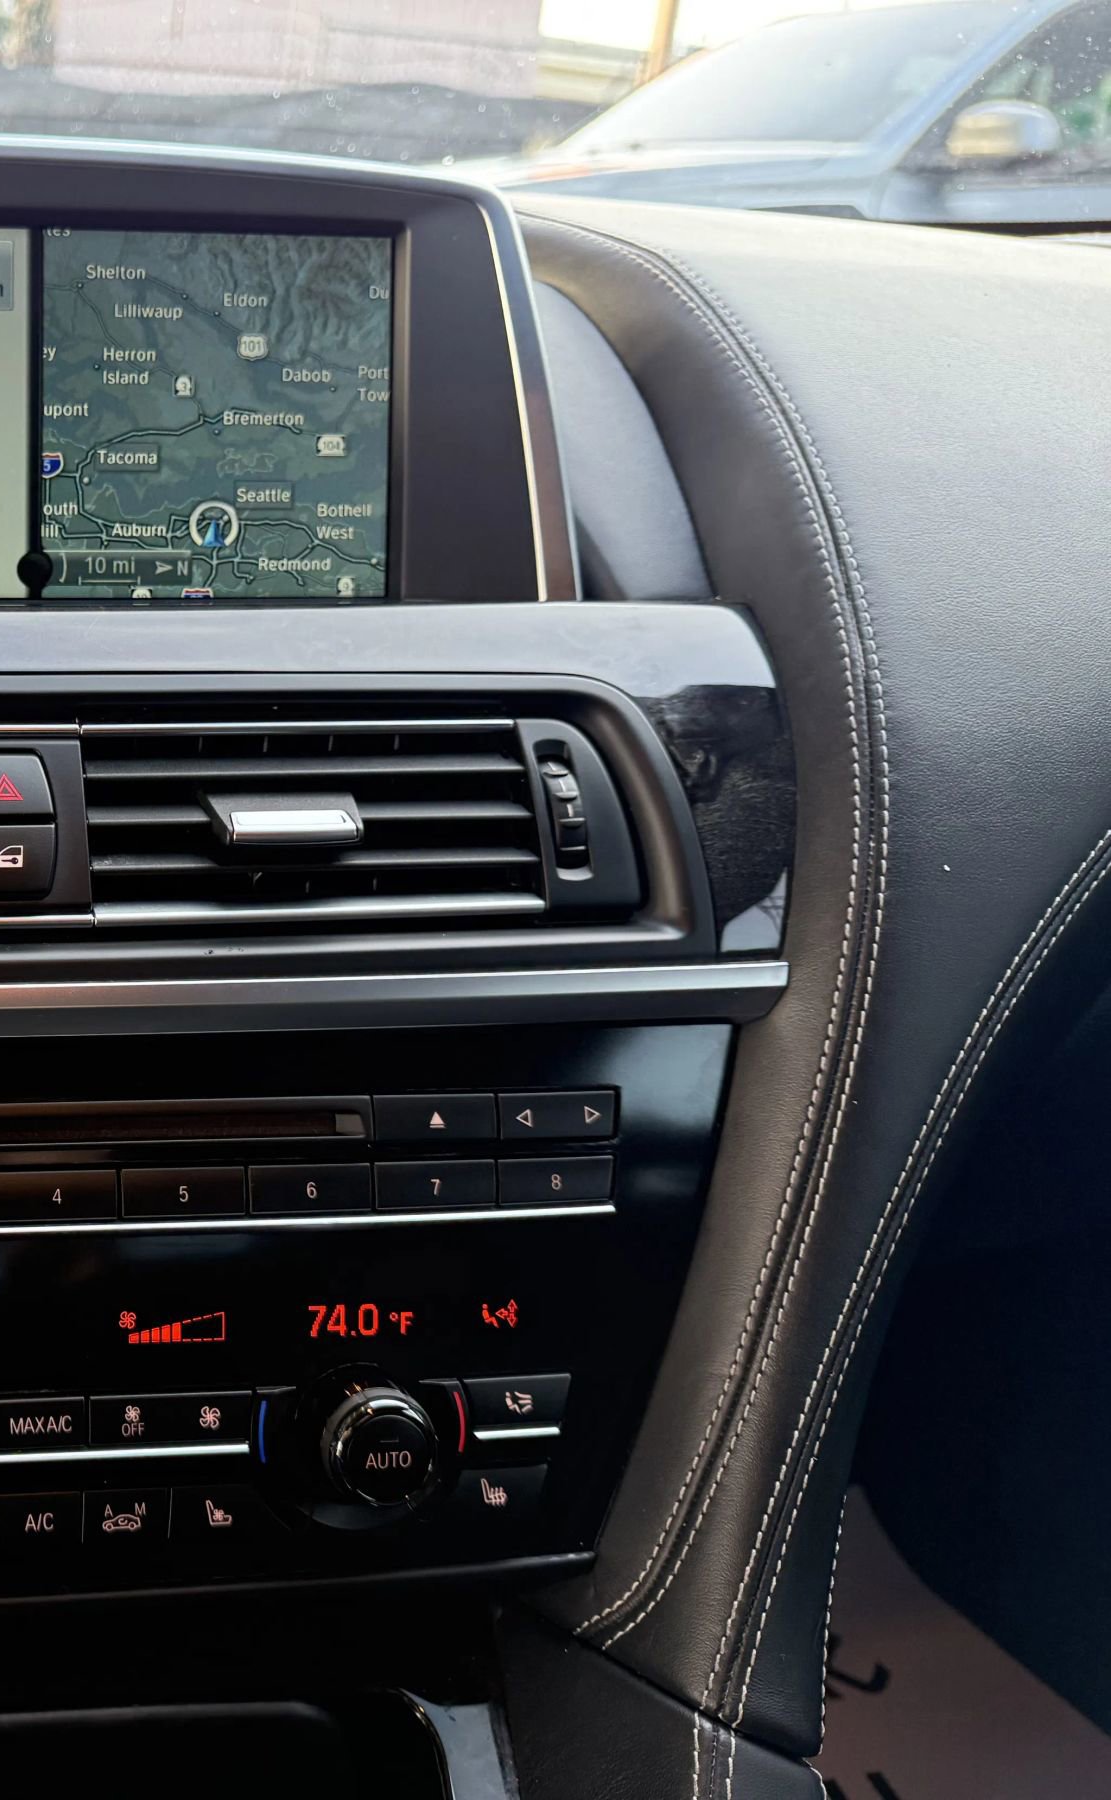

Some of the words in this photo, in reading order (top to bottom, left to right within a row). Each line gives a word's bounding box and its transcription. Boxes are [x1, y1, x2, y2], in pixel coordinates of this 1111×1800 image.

[86, 264, 146, 280] Shelton
[223, 293, 268, 308] Eldon
[114, 304, 183, 320] Lilliwaup
[243, 340, 262, 350] 101
[103, 347, 157, 362] Herron
[103, 371, 149, 385] Island
[282, 368, 332, 383] Dabob
[358, 366, 388, 380] Port
[43, 403, 89, 419] upont
[223, 411, 304, 426] Bremerton
[97, 450, 158, 465] Tacoma
[43, 460, 51, 472] 5
[237, 488, 291, 503] Seattle
[43, 502, 78, 516] outh
[316, 503, 371, 518] Bothell
[112, 523, 167, 537] Auburn
[316, 525, 354, 540] West
[85, 556, 107, 574] 10
[113, 556, 135, 574] mi
[177, 561, 188, 576] N
[258, 557, 331, 571] Redmond
[430, 1179, 440, 1196] 7
[550, 1175, 561, 1190] 8
[52, 1189, 62, 1206] 4
[178, 1186, 189, 1202] 5
[306, 1182, 317, 1199] 6
[307, 1303, 379, 1338] 74.0
[389, 1311, 414, 1335] °F
[9, 1417, 46, 1434] MAX
[46, 1415, 72, 1433] A/C
[121, 1423, 145, 1437] OFF
[365, 1451, 412, 1470] AUTO
[104, 1505, 113, 1517] A
[135, 1502, 146, 1516] M
[25, 1513, 54, 1531] A/C
